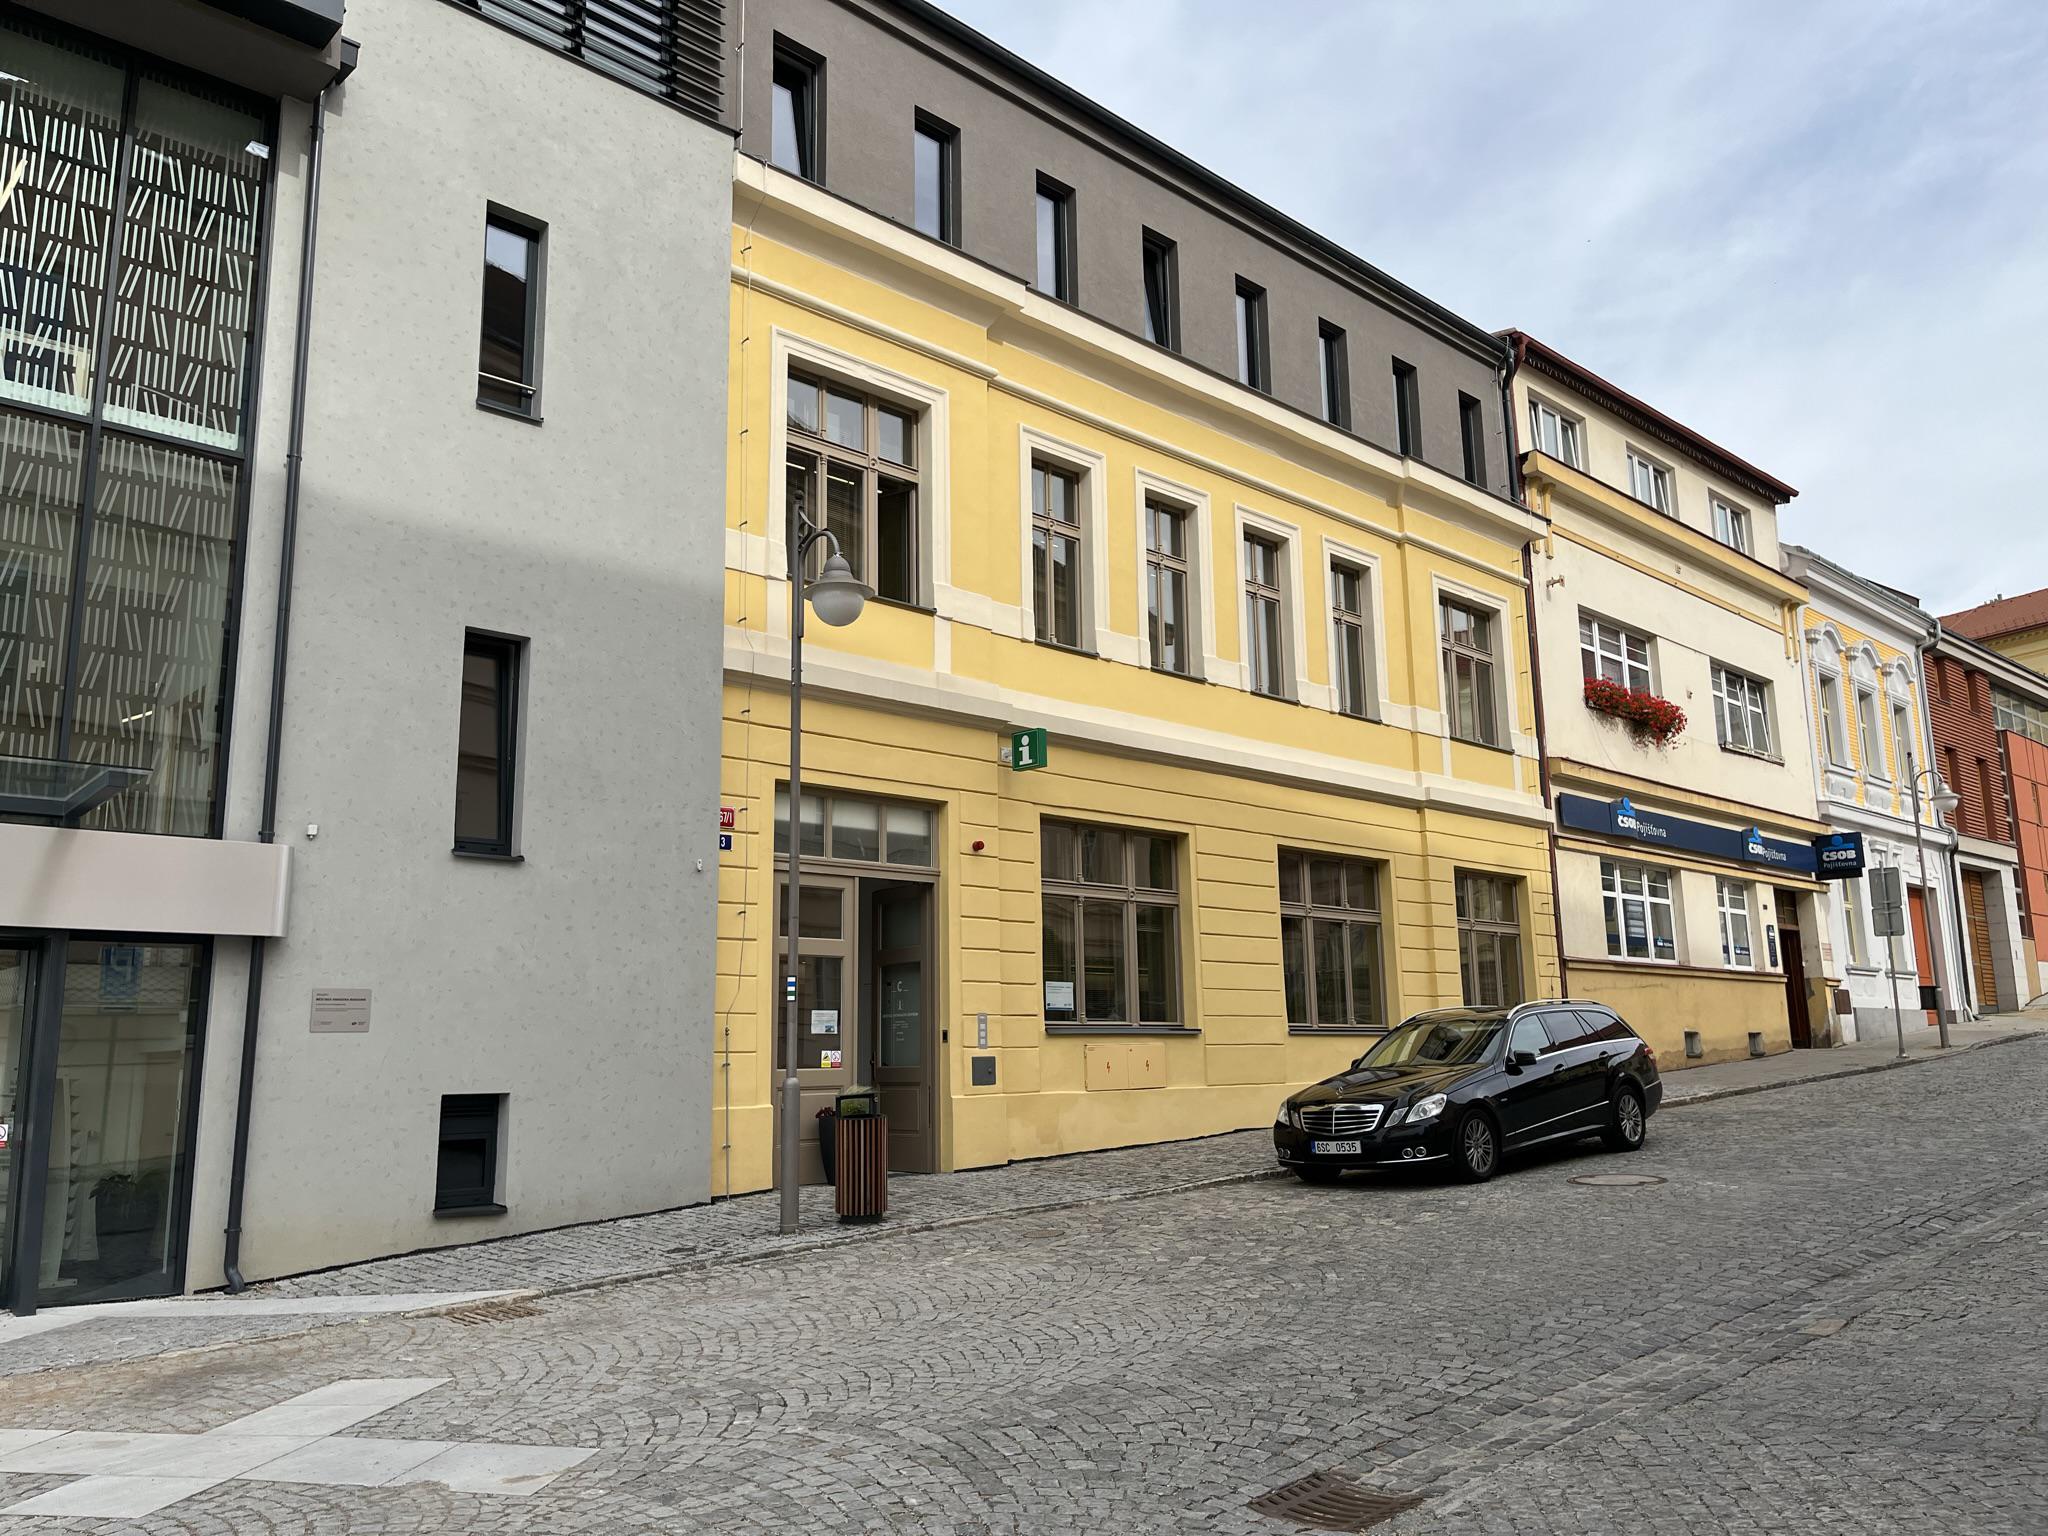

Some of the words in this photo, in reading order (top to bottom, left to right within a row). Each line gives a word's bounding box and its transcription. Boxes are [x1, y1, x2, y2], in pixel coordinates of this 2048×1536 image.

[1822, 849, 1857, 862] ČSOB
[1316, 1142, 1331, 1153] 6SC
[1335, 1142, 1357, 1153] 0535
